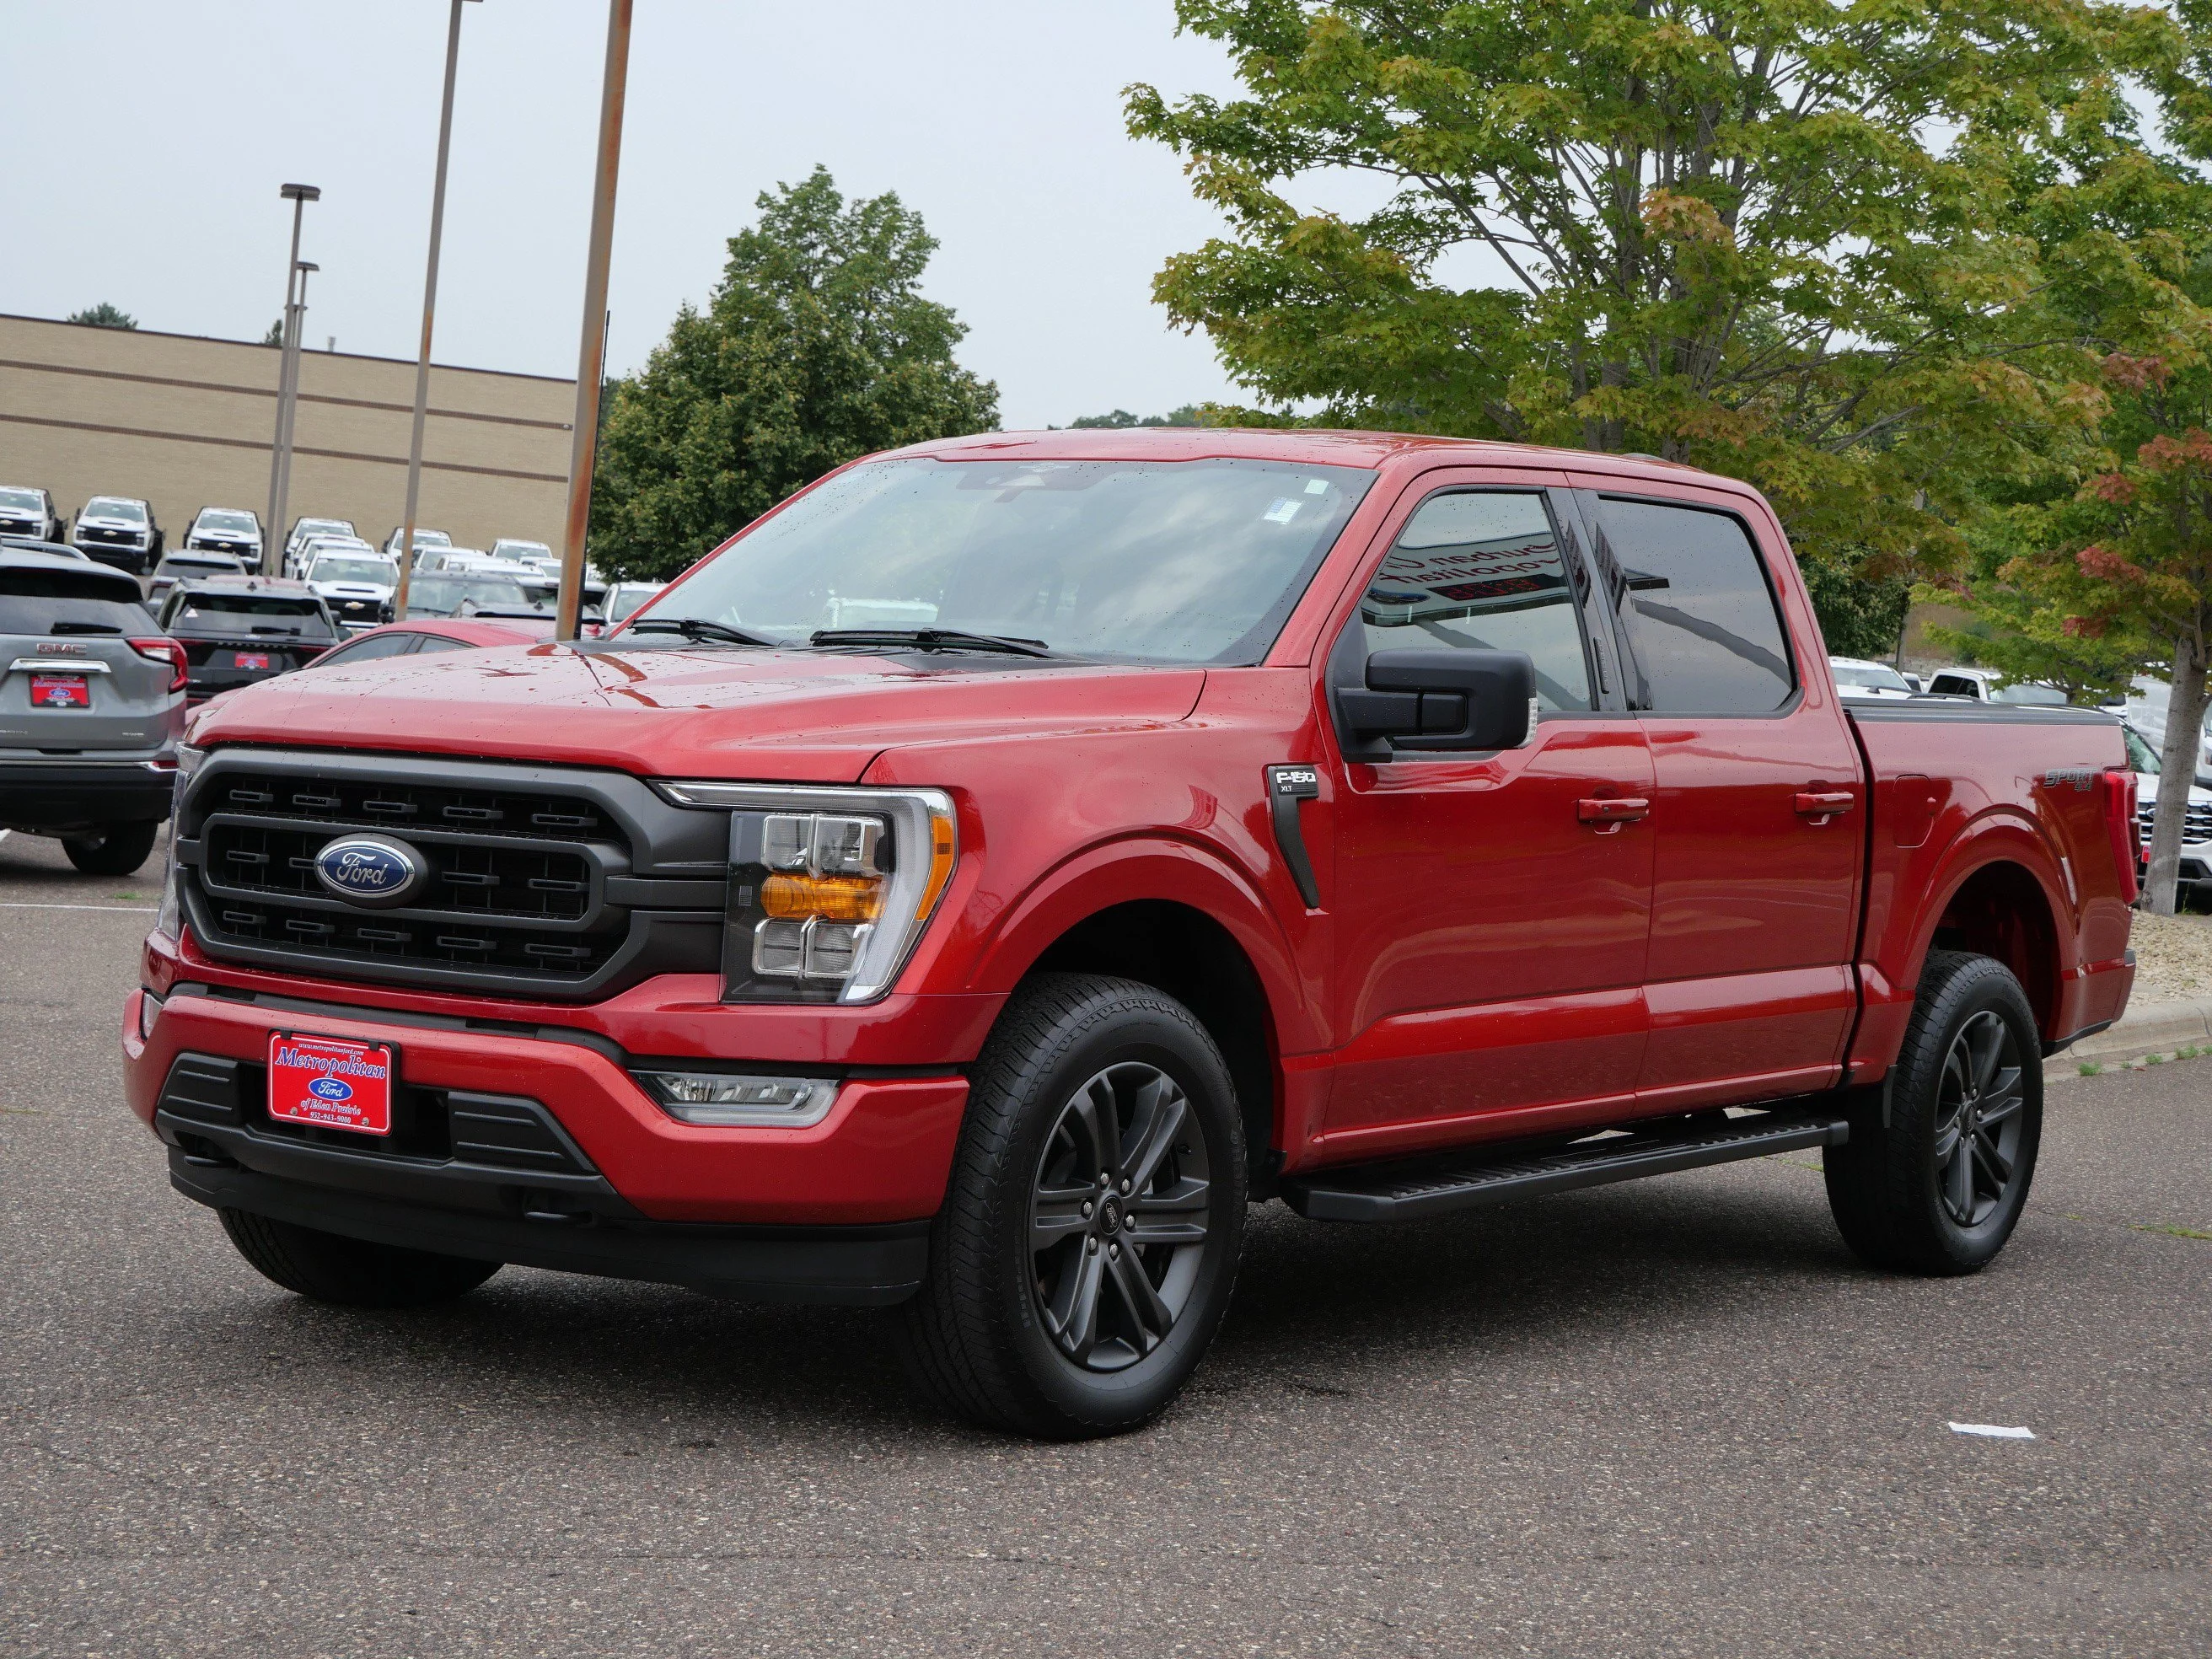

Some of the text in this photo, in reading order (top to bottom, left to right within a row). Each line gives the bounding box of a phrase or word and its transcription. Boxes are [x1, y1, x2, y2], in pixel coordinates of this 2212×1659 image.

[36, 643, 87, 655] GMC
[1276, 771, 1316, 783] F-150
[2043, 767, 2097, 788] SPORT
[336, 851, 389, 885] Ford
[298, 1043, 363, 1056] www.metropolitanford.com
[275, 1046, 385, 1079] Metropolitan
[318, 1081, 344, 1097] Ford
[300, 1098, 361, 1115] of Eden Prairie
[309, 1112, 351, 1124] 952-943-9000
[1106, 1205, 1117, 1225] Ford
